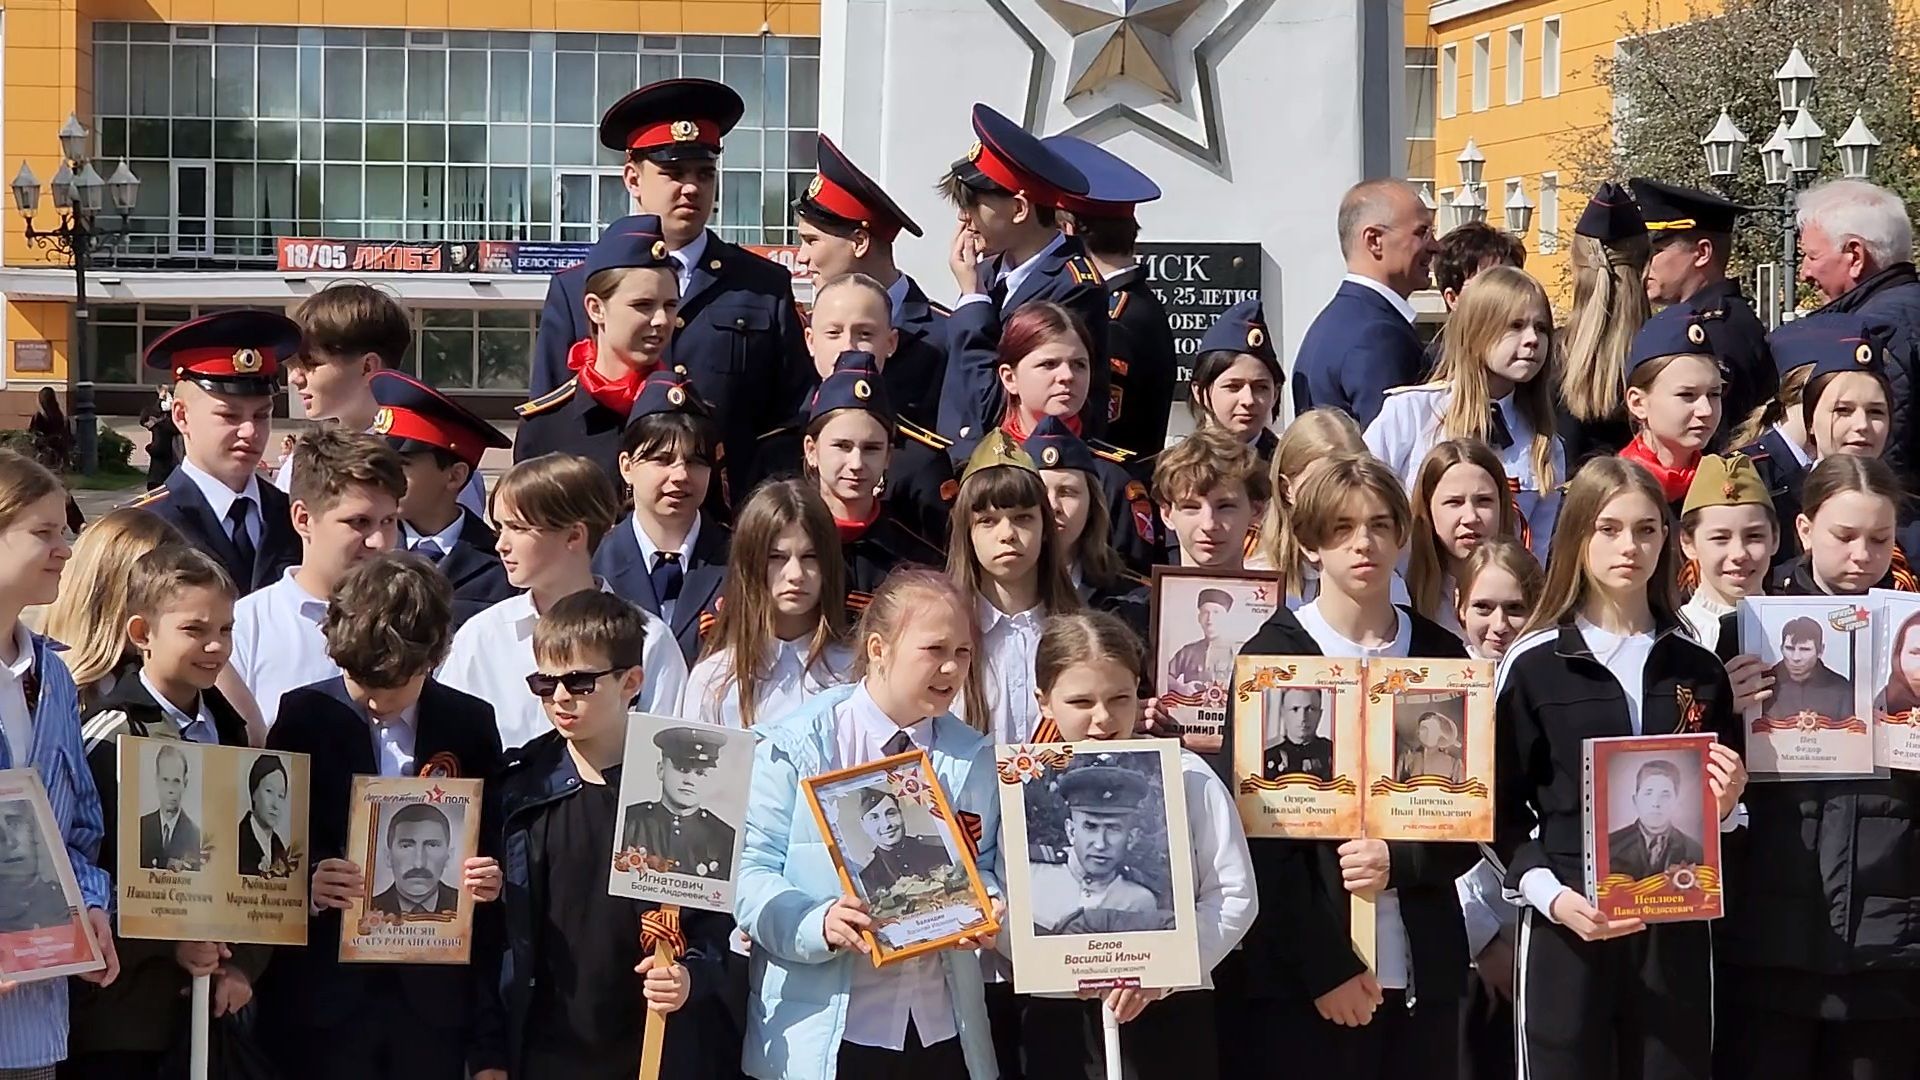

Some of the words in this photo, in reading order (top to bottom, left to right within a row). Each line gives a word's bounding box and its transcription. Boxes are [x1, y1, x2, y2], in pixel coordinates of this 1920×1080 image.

[284, 244, 347, 269] 18/05
[1132, 254, 1211, 281] ИСК
[1172, 286, 1196, 305] 25
[1199, 288, 1258, 306] ЛЕТИЯ
[1197, 709, 1225, 722] Попо
[1391, 807, 1414, 816] Иван
[639, 872, 704, 891] Игнатович
[631, 881, 659, 893] Борис
[660, 887, 710, 901] Андреевич
[1634, 894, 1685, 905] Неплюев
[1088, 940, 1123, 951] Белов
[1064, 951, 1113, 965] Василий
[1115, 951, 1151, 962] Ильич
